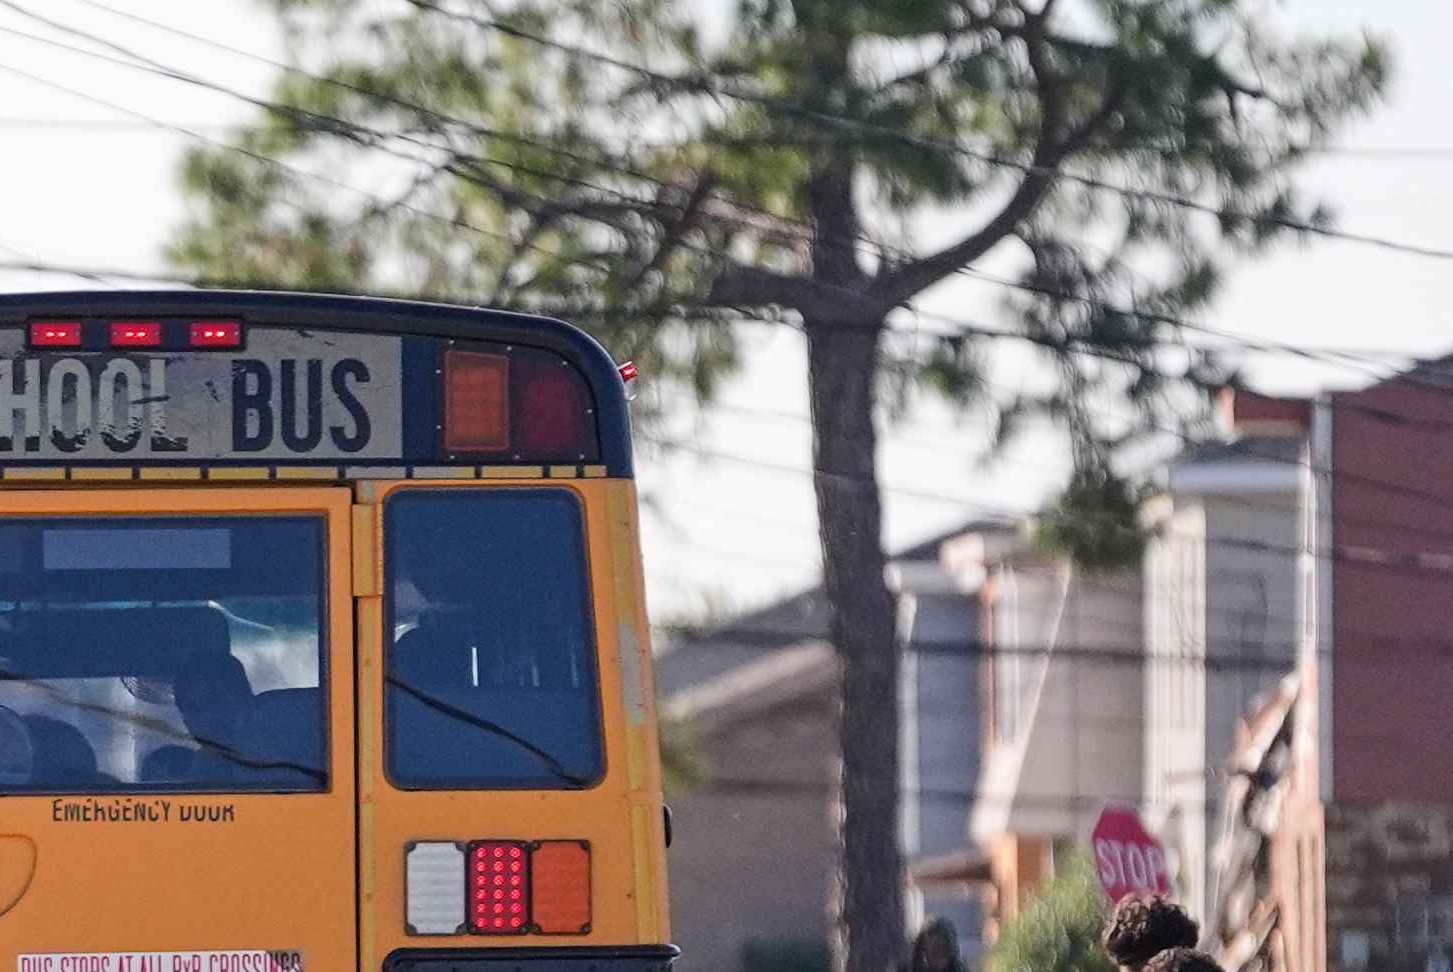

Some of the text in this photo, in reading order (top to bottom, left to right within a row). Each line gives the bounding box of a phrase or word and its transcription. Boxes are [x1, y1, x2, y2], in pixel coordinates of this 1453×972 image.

[232, 359, 372, 454] BUS
[52, 798, 171, 822] EMERGENCY
[1095, 837, 1168, 892] STOP
